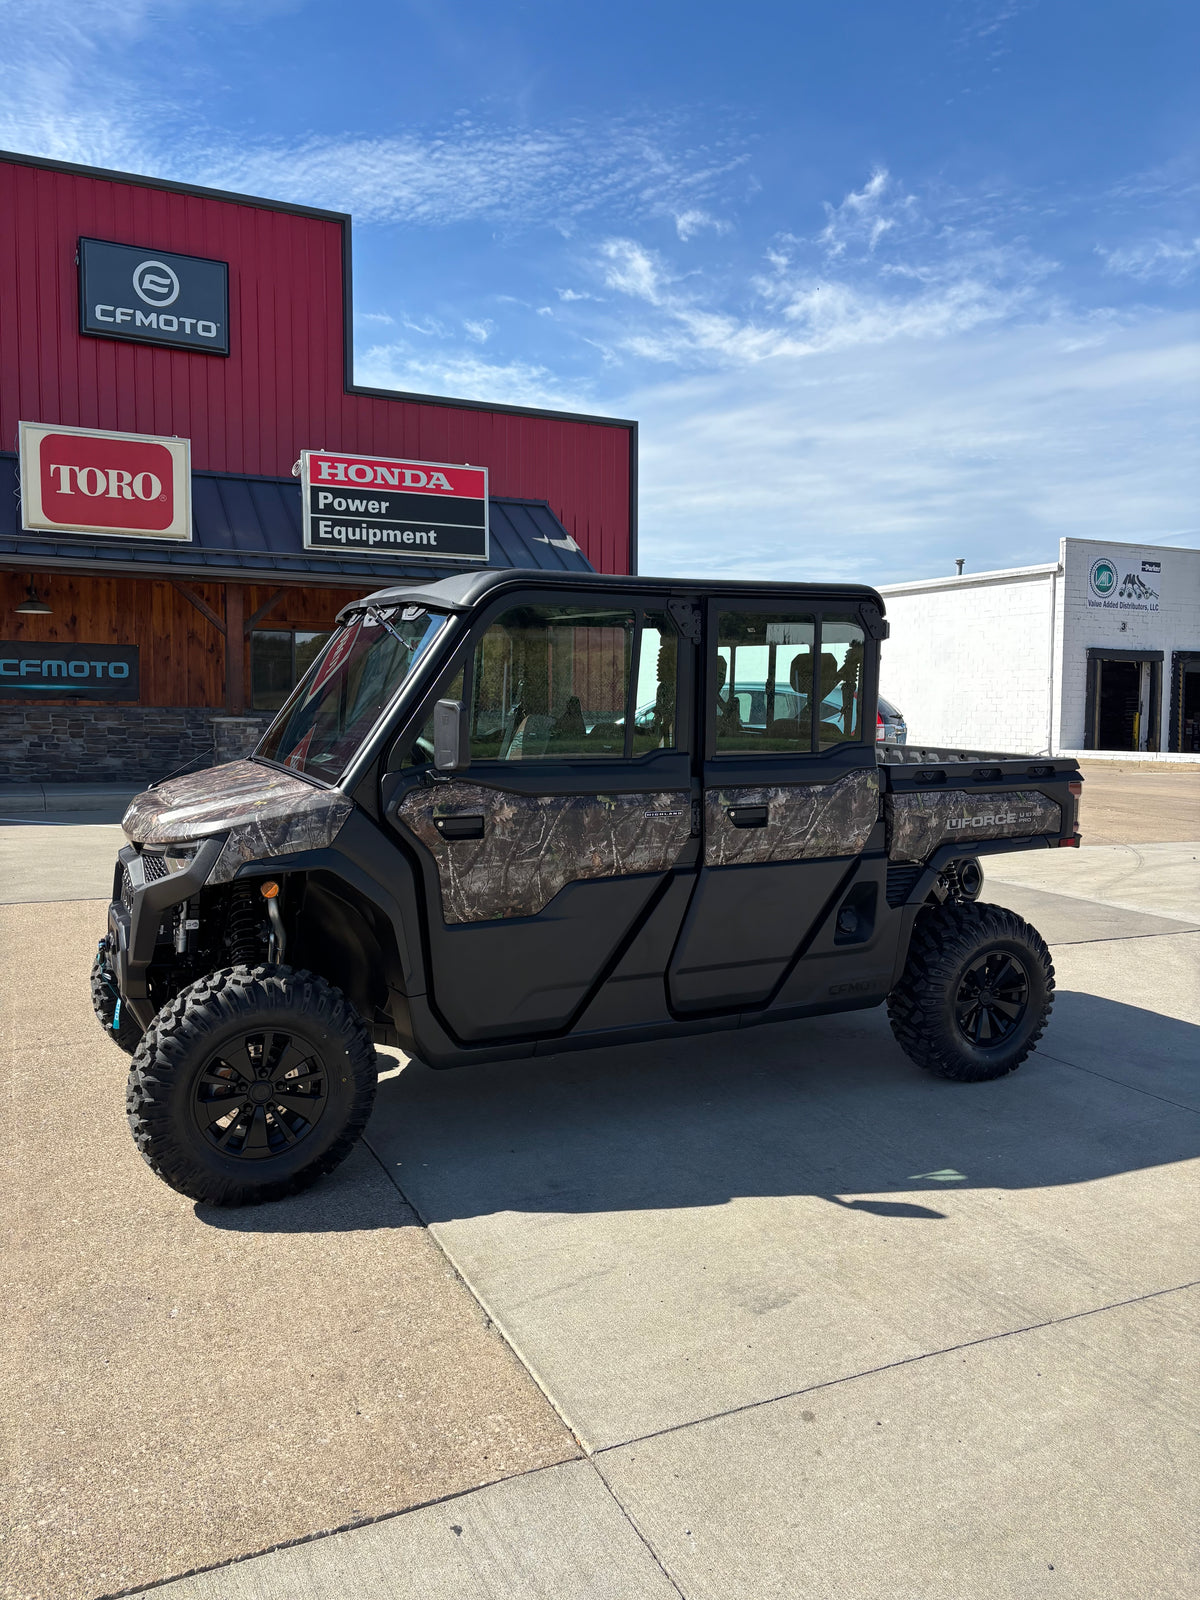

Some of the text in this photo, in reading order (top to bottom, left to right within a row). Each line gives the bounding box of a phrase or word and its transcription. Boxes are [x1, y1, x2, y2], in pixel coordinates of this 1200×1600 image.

[95, 304, 217, 338] CFMOTO
[50, 464, 162, 501] TORO
[317, 461, 454, 491] HONDA
[318, 491, 390, 514] Power
[319, 520, 437, 545] Equipment
[1088, 599, 1159, 612] Value Added Distributors, LLC
[1121, 622, 1127, 631] 3
[0, 659, 129, 679] CFMOTO
[828, 979, 884, 995] CFMO
